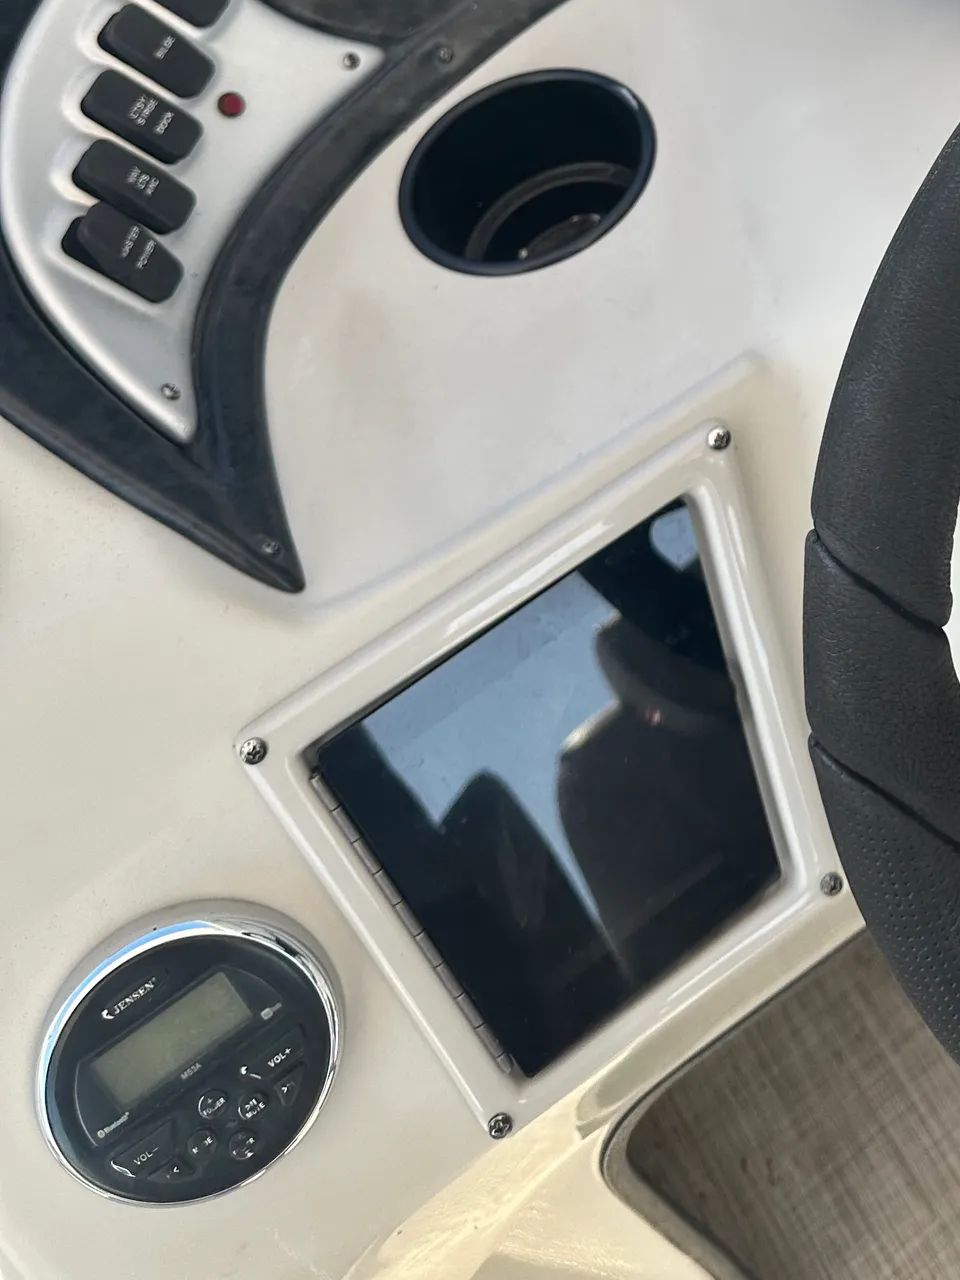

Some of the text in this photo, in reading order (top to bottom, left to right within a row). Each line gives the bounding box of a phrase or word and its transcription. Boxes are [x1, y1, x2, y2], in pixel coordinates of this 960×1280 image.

[154, 34, 176, 61] BILGE
[113, 980, 156, 1015] JENSEN
[267, 1047, 292, 1068] VOL+
[133, 1146, 159, 1165] VOL-
